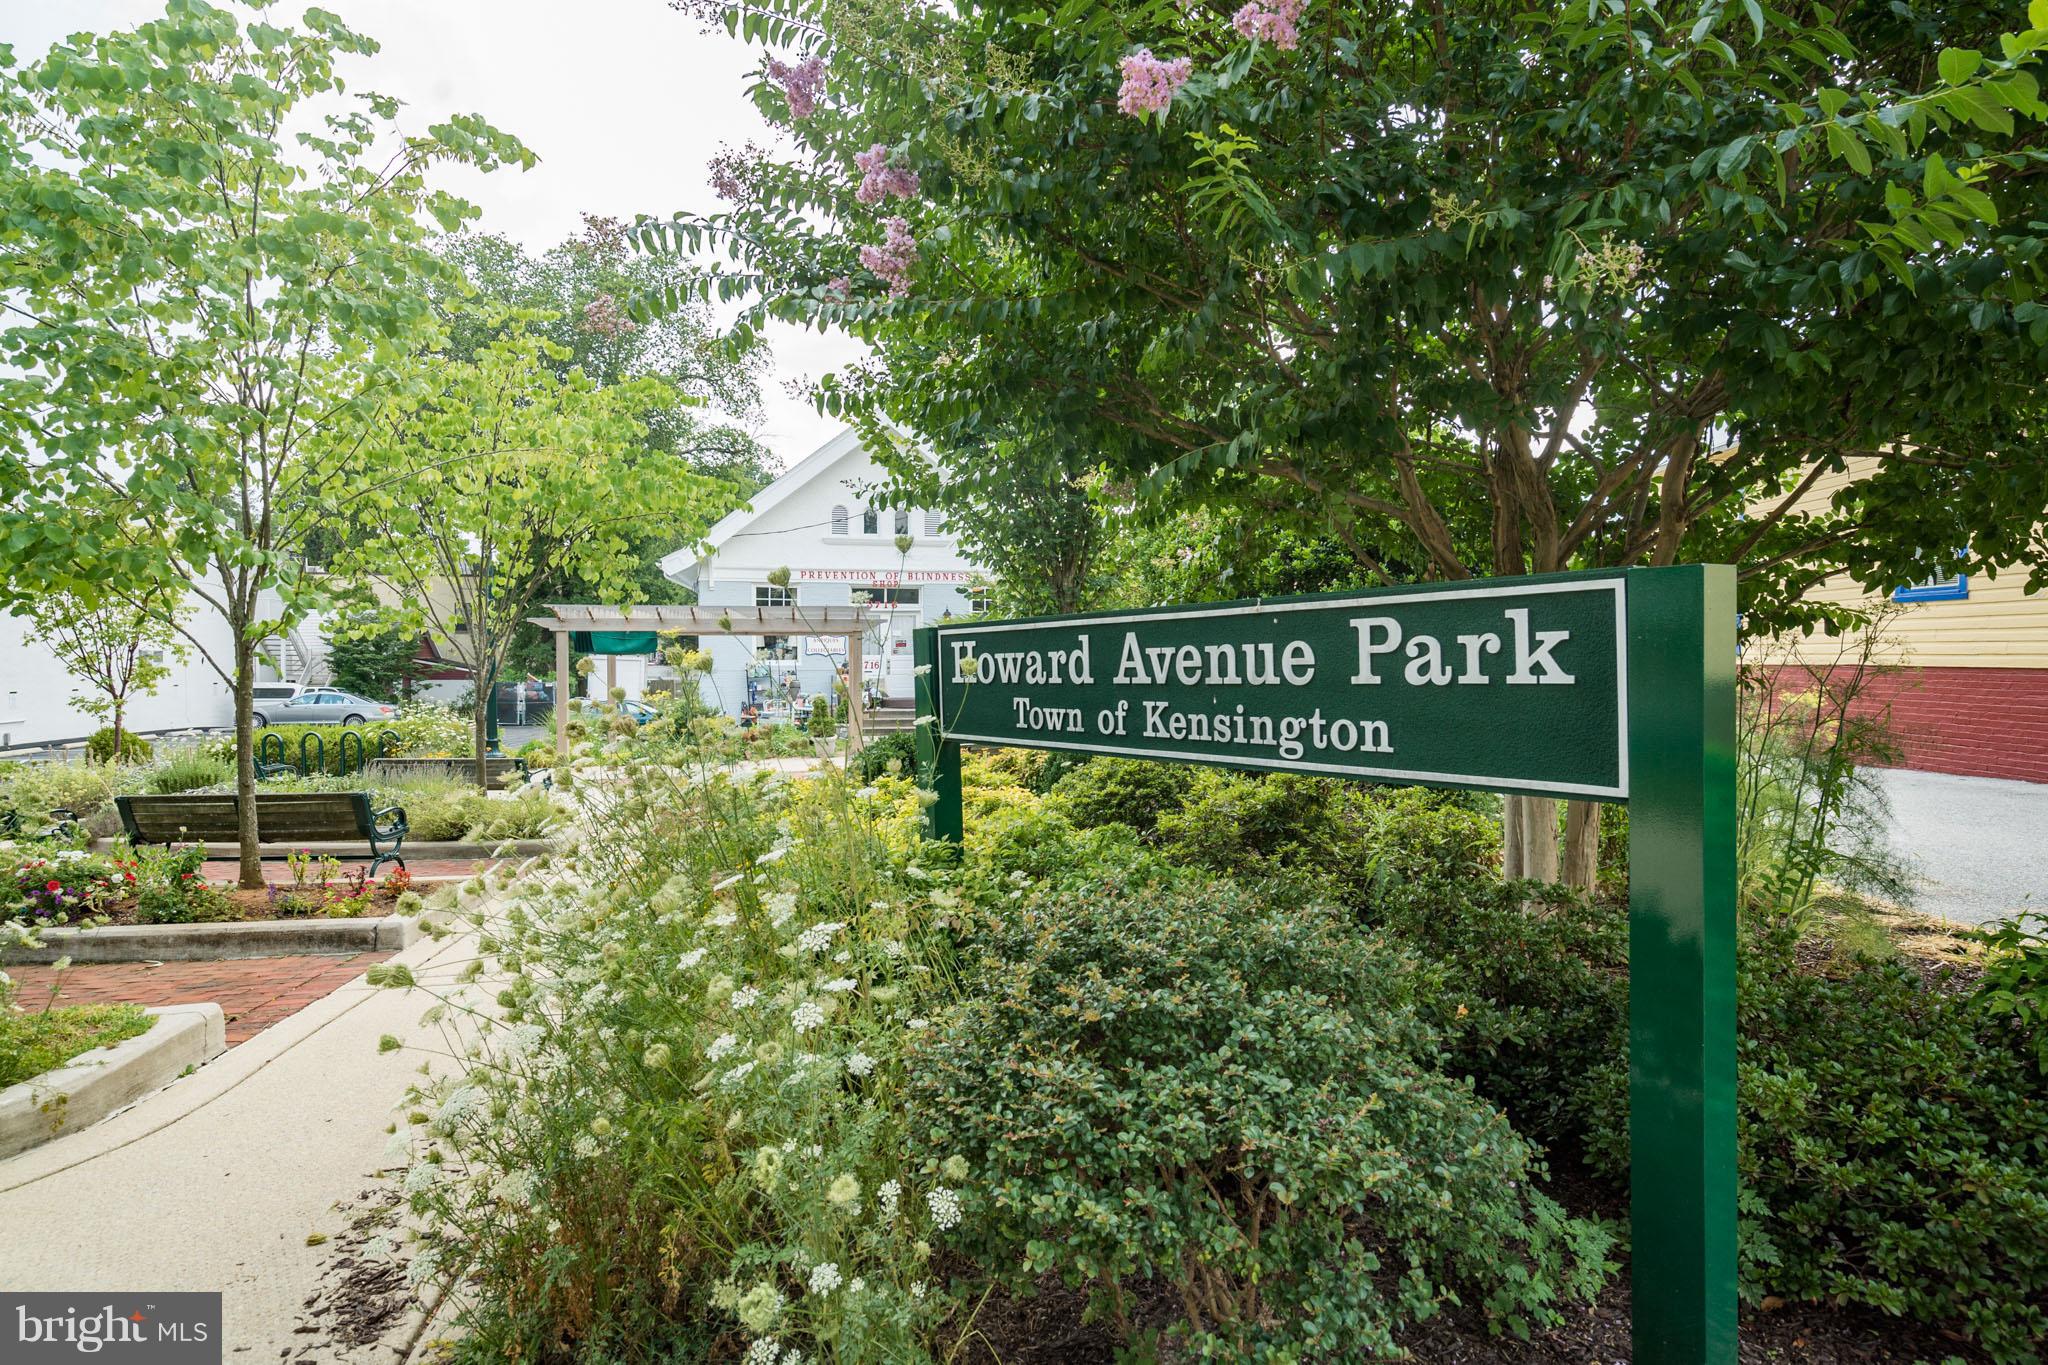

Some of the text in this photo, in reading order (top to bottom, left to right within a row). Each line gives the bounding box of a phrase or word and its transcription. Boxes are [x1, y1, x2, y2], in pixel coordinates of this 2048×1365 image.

[800, 570, 972, 581] PREVENTION OF BLINDNESS
[872, 580, 899, 588] SHOP
[950, 607, 1576, 686] Howard Avenue Park
[1013, 697, 1395, 760] Town of Kensington
